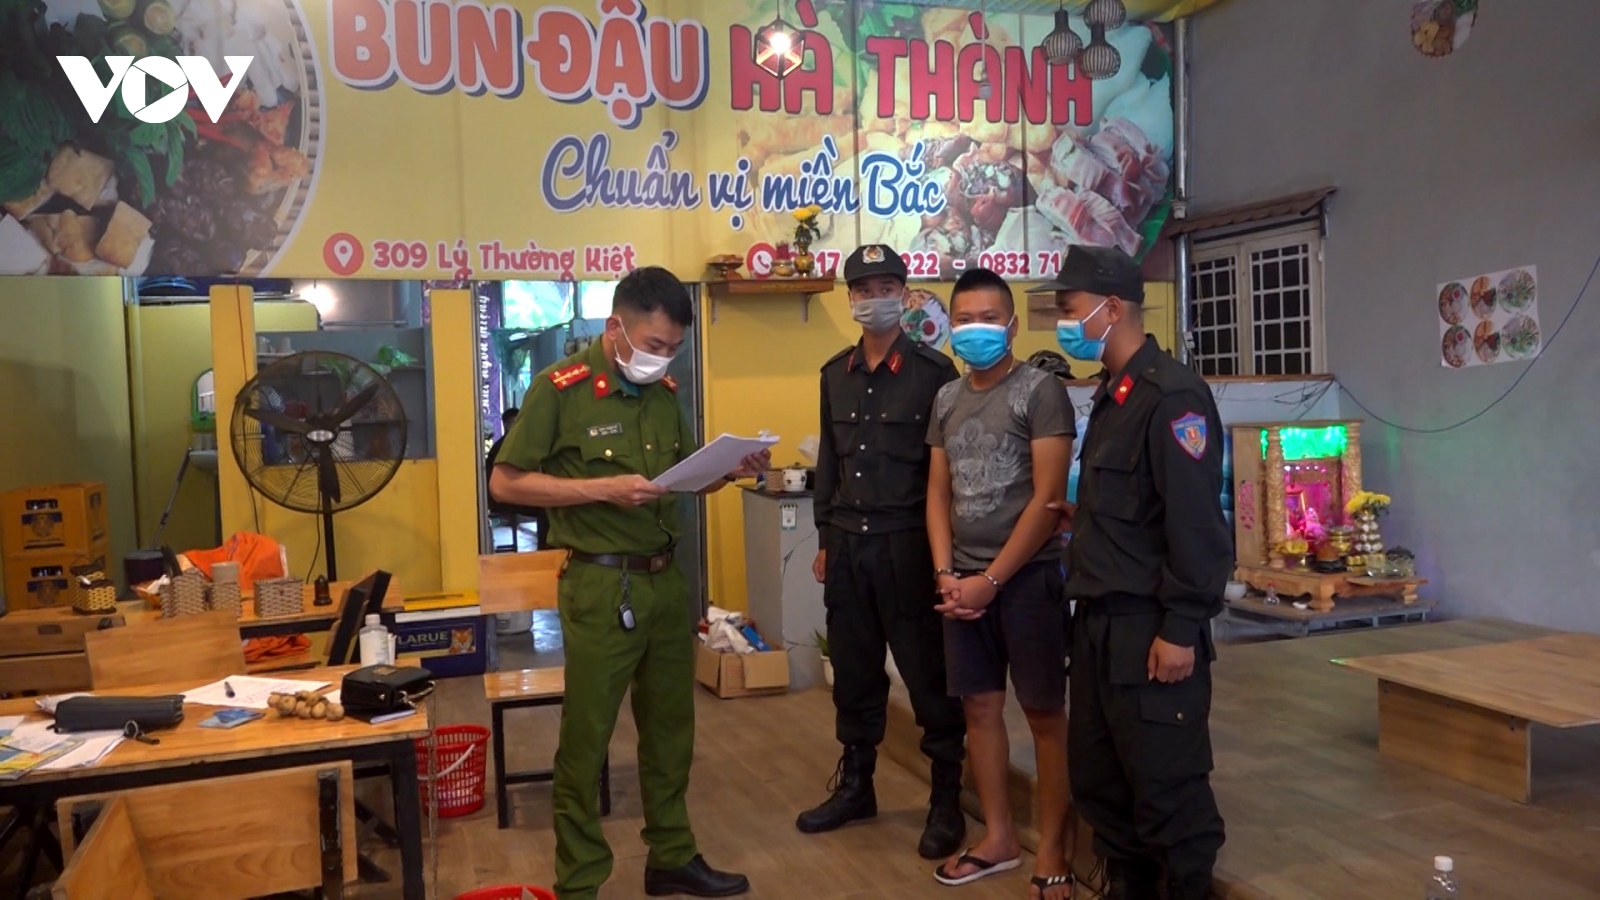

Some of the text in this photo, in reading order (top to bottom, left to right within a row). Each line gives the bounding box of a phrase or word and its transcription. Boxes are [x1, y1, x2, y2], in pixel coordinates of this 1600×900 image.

[526, 0, 707, 127] ĐẬU
[730, 0, 834, 115] HÀ
[866, 12, 1093, 125] THÀNH
[541, 130, 946, 230] Chuẩn vị miền Bắc
[372, 239, 636, 280] 309 Lý Thường Kiệt
[978, 252, 1030, 276] 0832
[398, 631, 448, 645] LARUE
